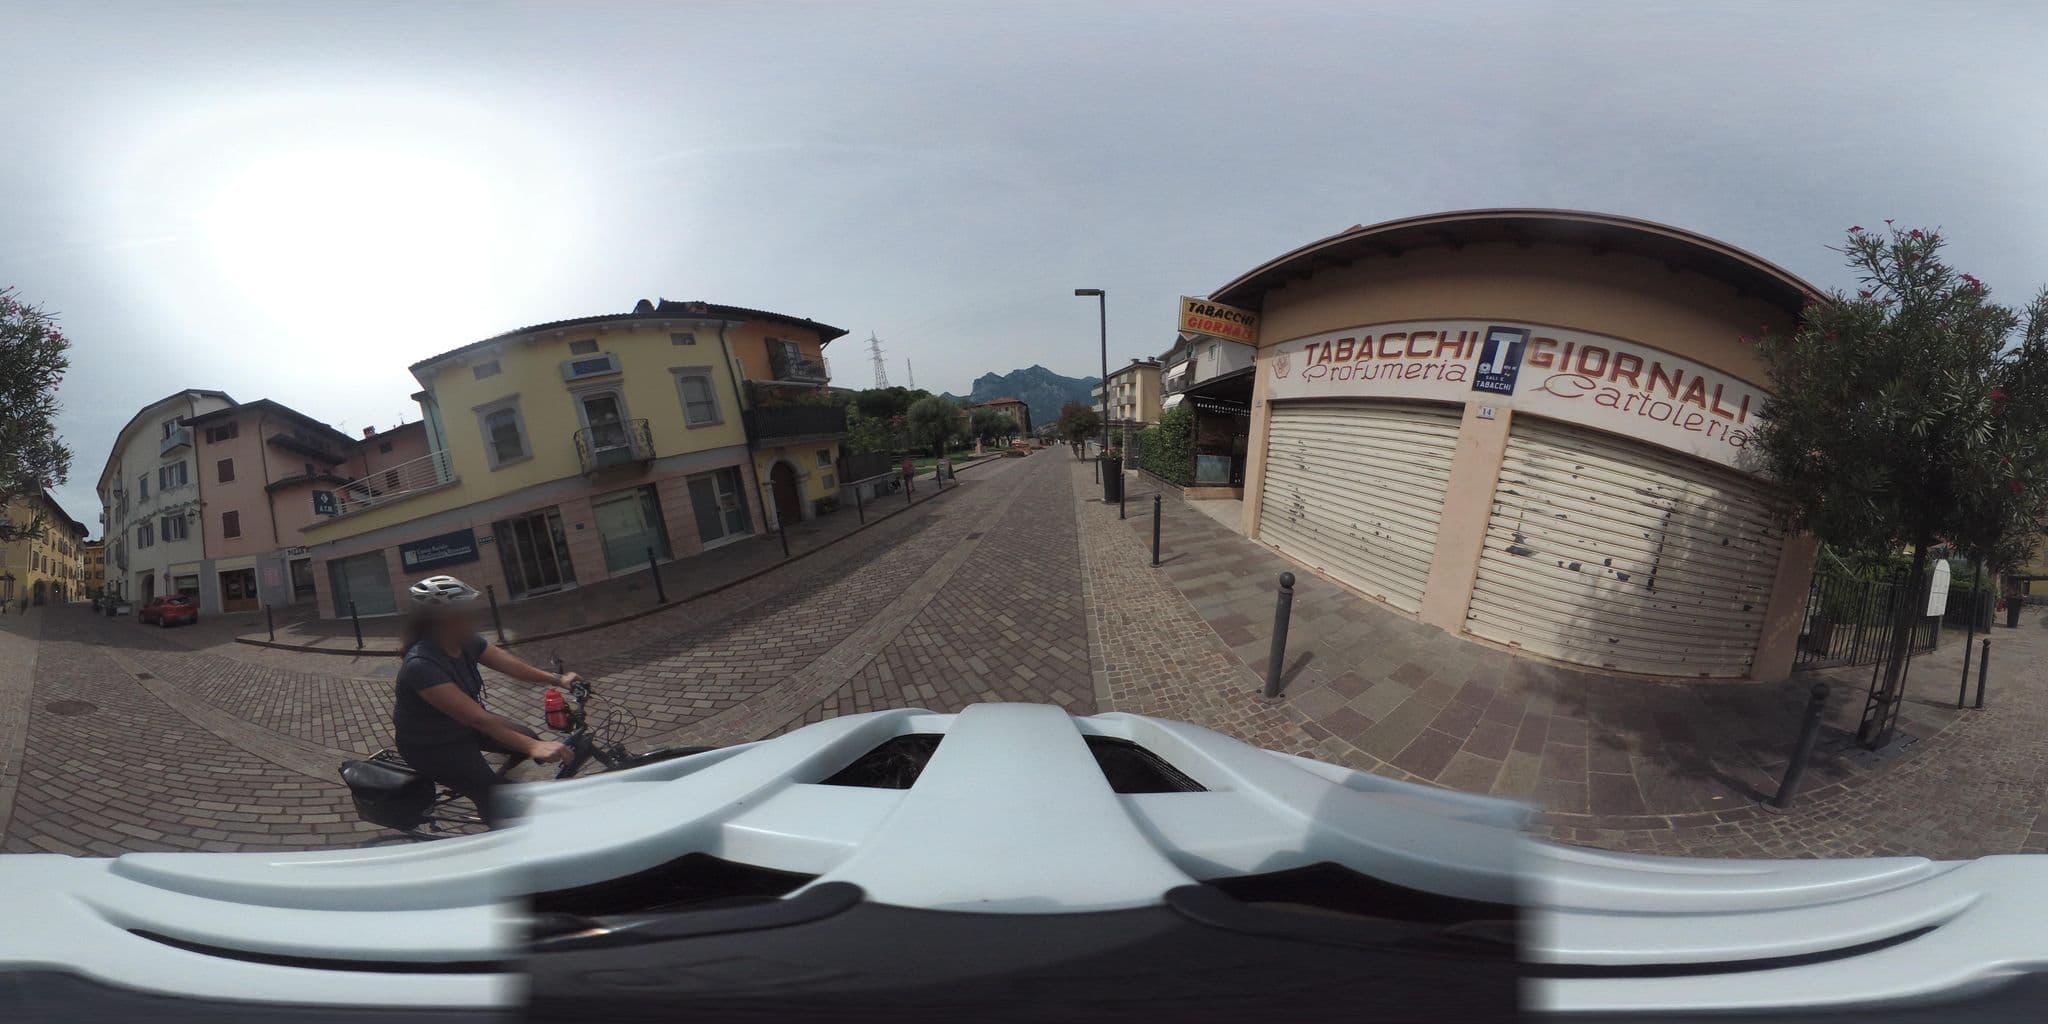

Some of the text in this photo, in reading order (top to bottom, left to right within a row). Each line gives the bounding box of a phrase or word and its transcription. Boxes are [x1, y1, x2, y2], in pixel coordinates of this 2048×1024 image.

[1189, 302, 1255, 326] TABACCHI
[1305, 330, 1480, 366] TABACCHI
[1490, 332, 1522, 374] T
[1302, 360, 1467, 383] Profumeria
[1476, 380, 1511, 391] TABACCHI
[1528, 337, 1751, 424] GIORNALI
[1530, 373, 1752, 450] Cartoleria
